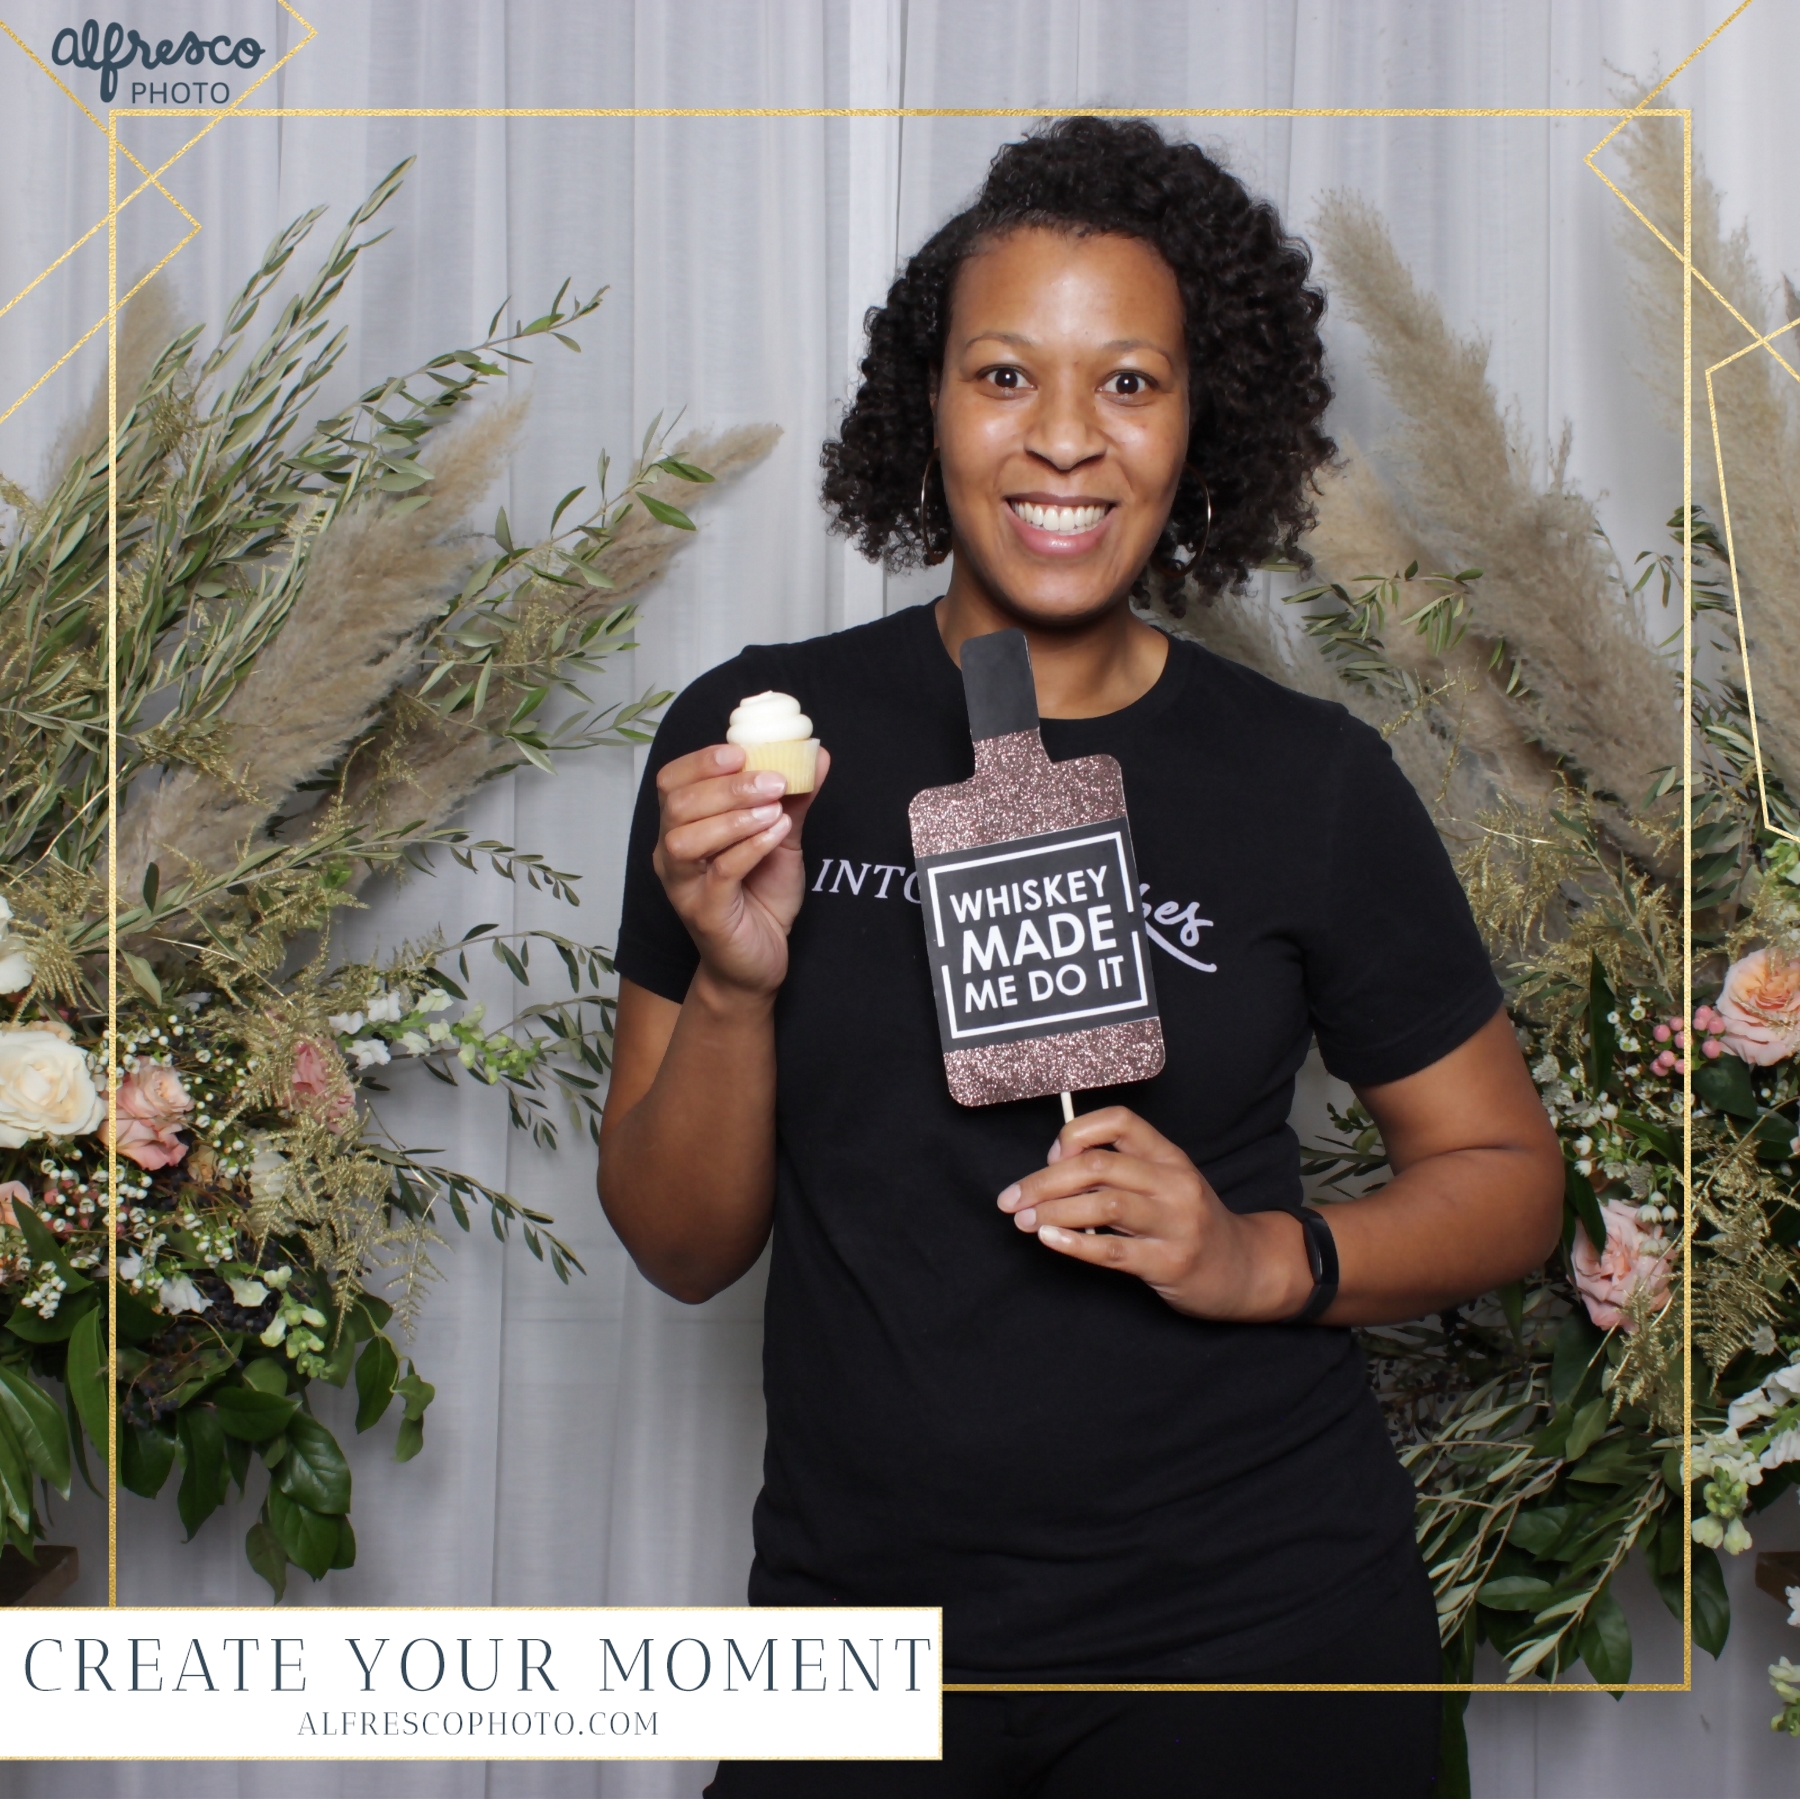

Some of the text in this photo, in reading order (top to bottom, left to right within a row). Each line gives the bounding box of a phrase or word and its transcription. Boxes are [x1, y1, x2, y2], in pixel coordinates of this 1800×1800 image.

[949, 865, 1108, 924] WHISKEY
[962, 904, 1117, 975] MADE
[964, 954, 1125, 1014] ME DO IT
